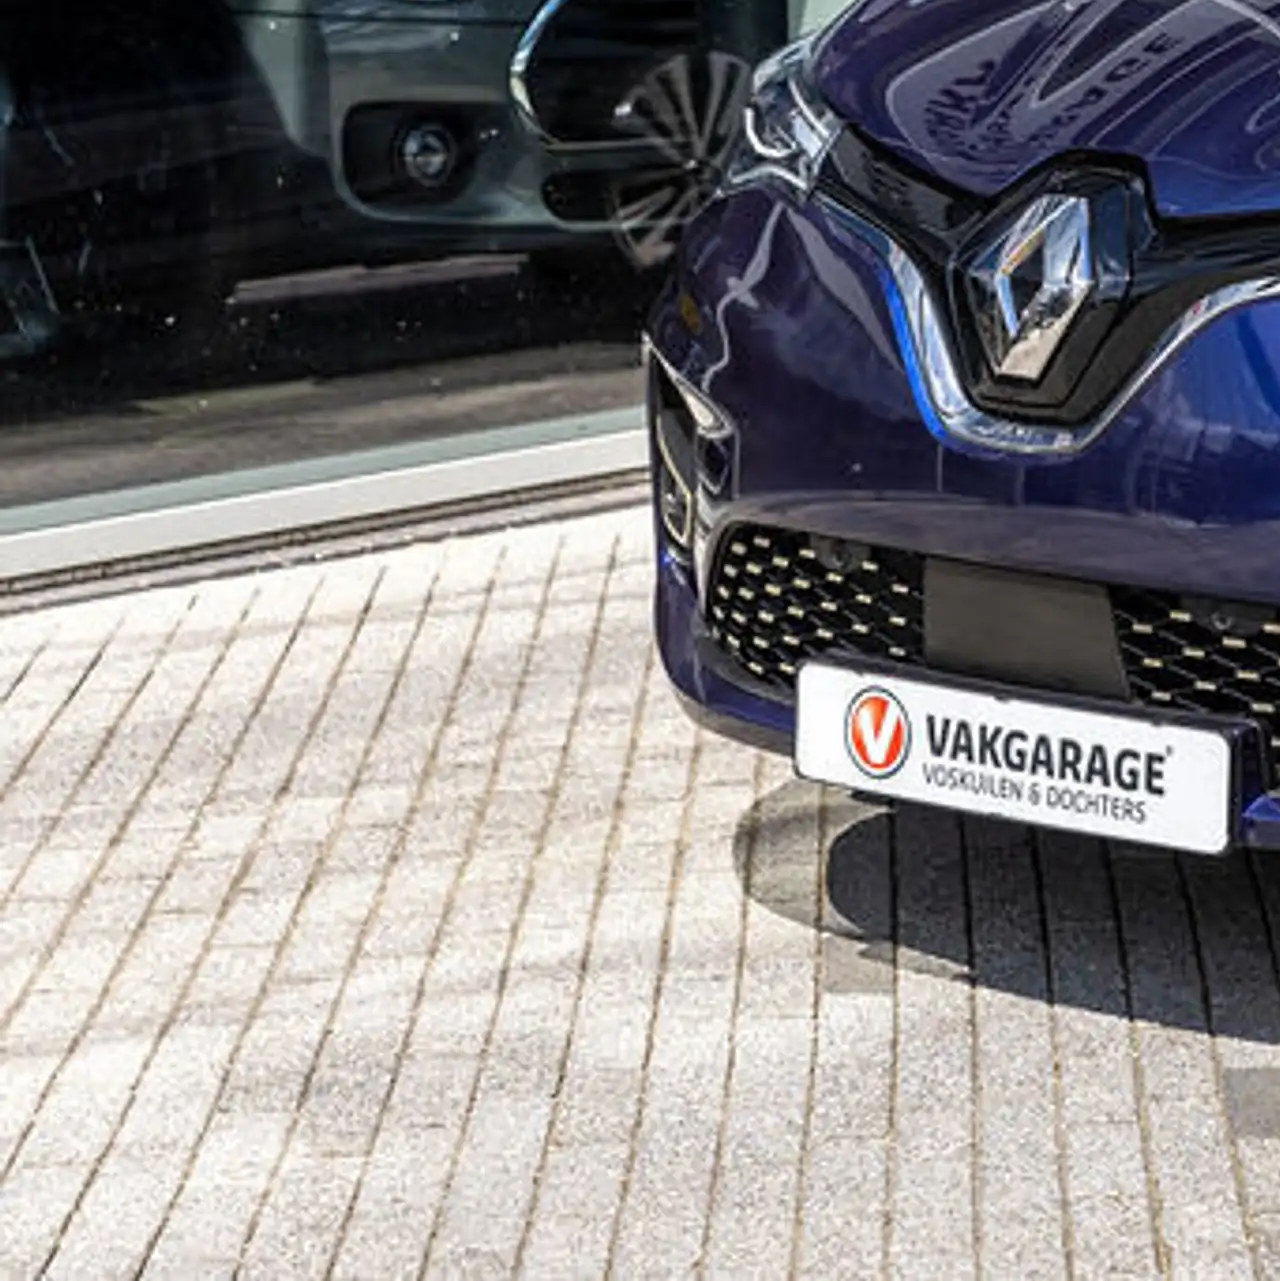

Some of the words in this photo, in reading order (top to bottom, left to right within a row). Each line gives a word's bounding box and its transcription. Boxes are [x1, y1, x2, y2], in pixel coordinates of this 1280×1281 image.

[925, 713, 1167, 797] VAKGARAGE
[921, 762, 1024, 802] VOSKUILEN
[1028, 781, 1041, 806] &
[1045, 783, 1147, 824] DOCHTERS
